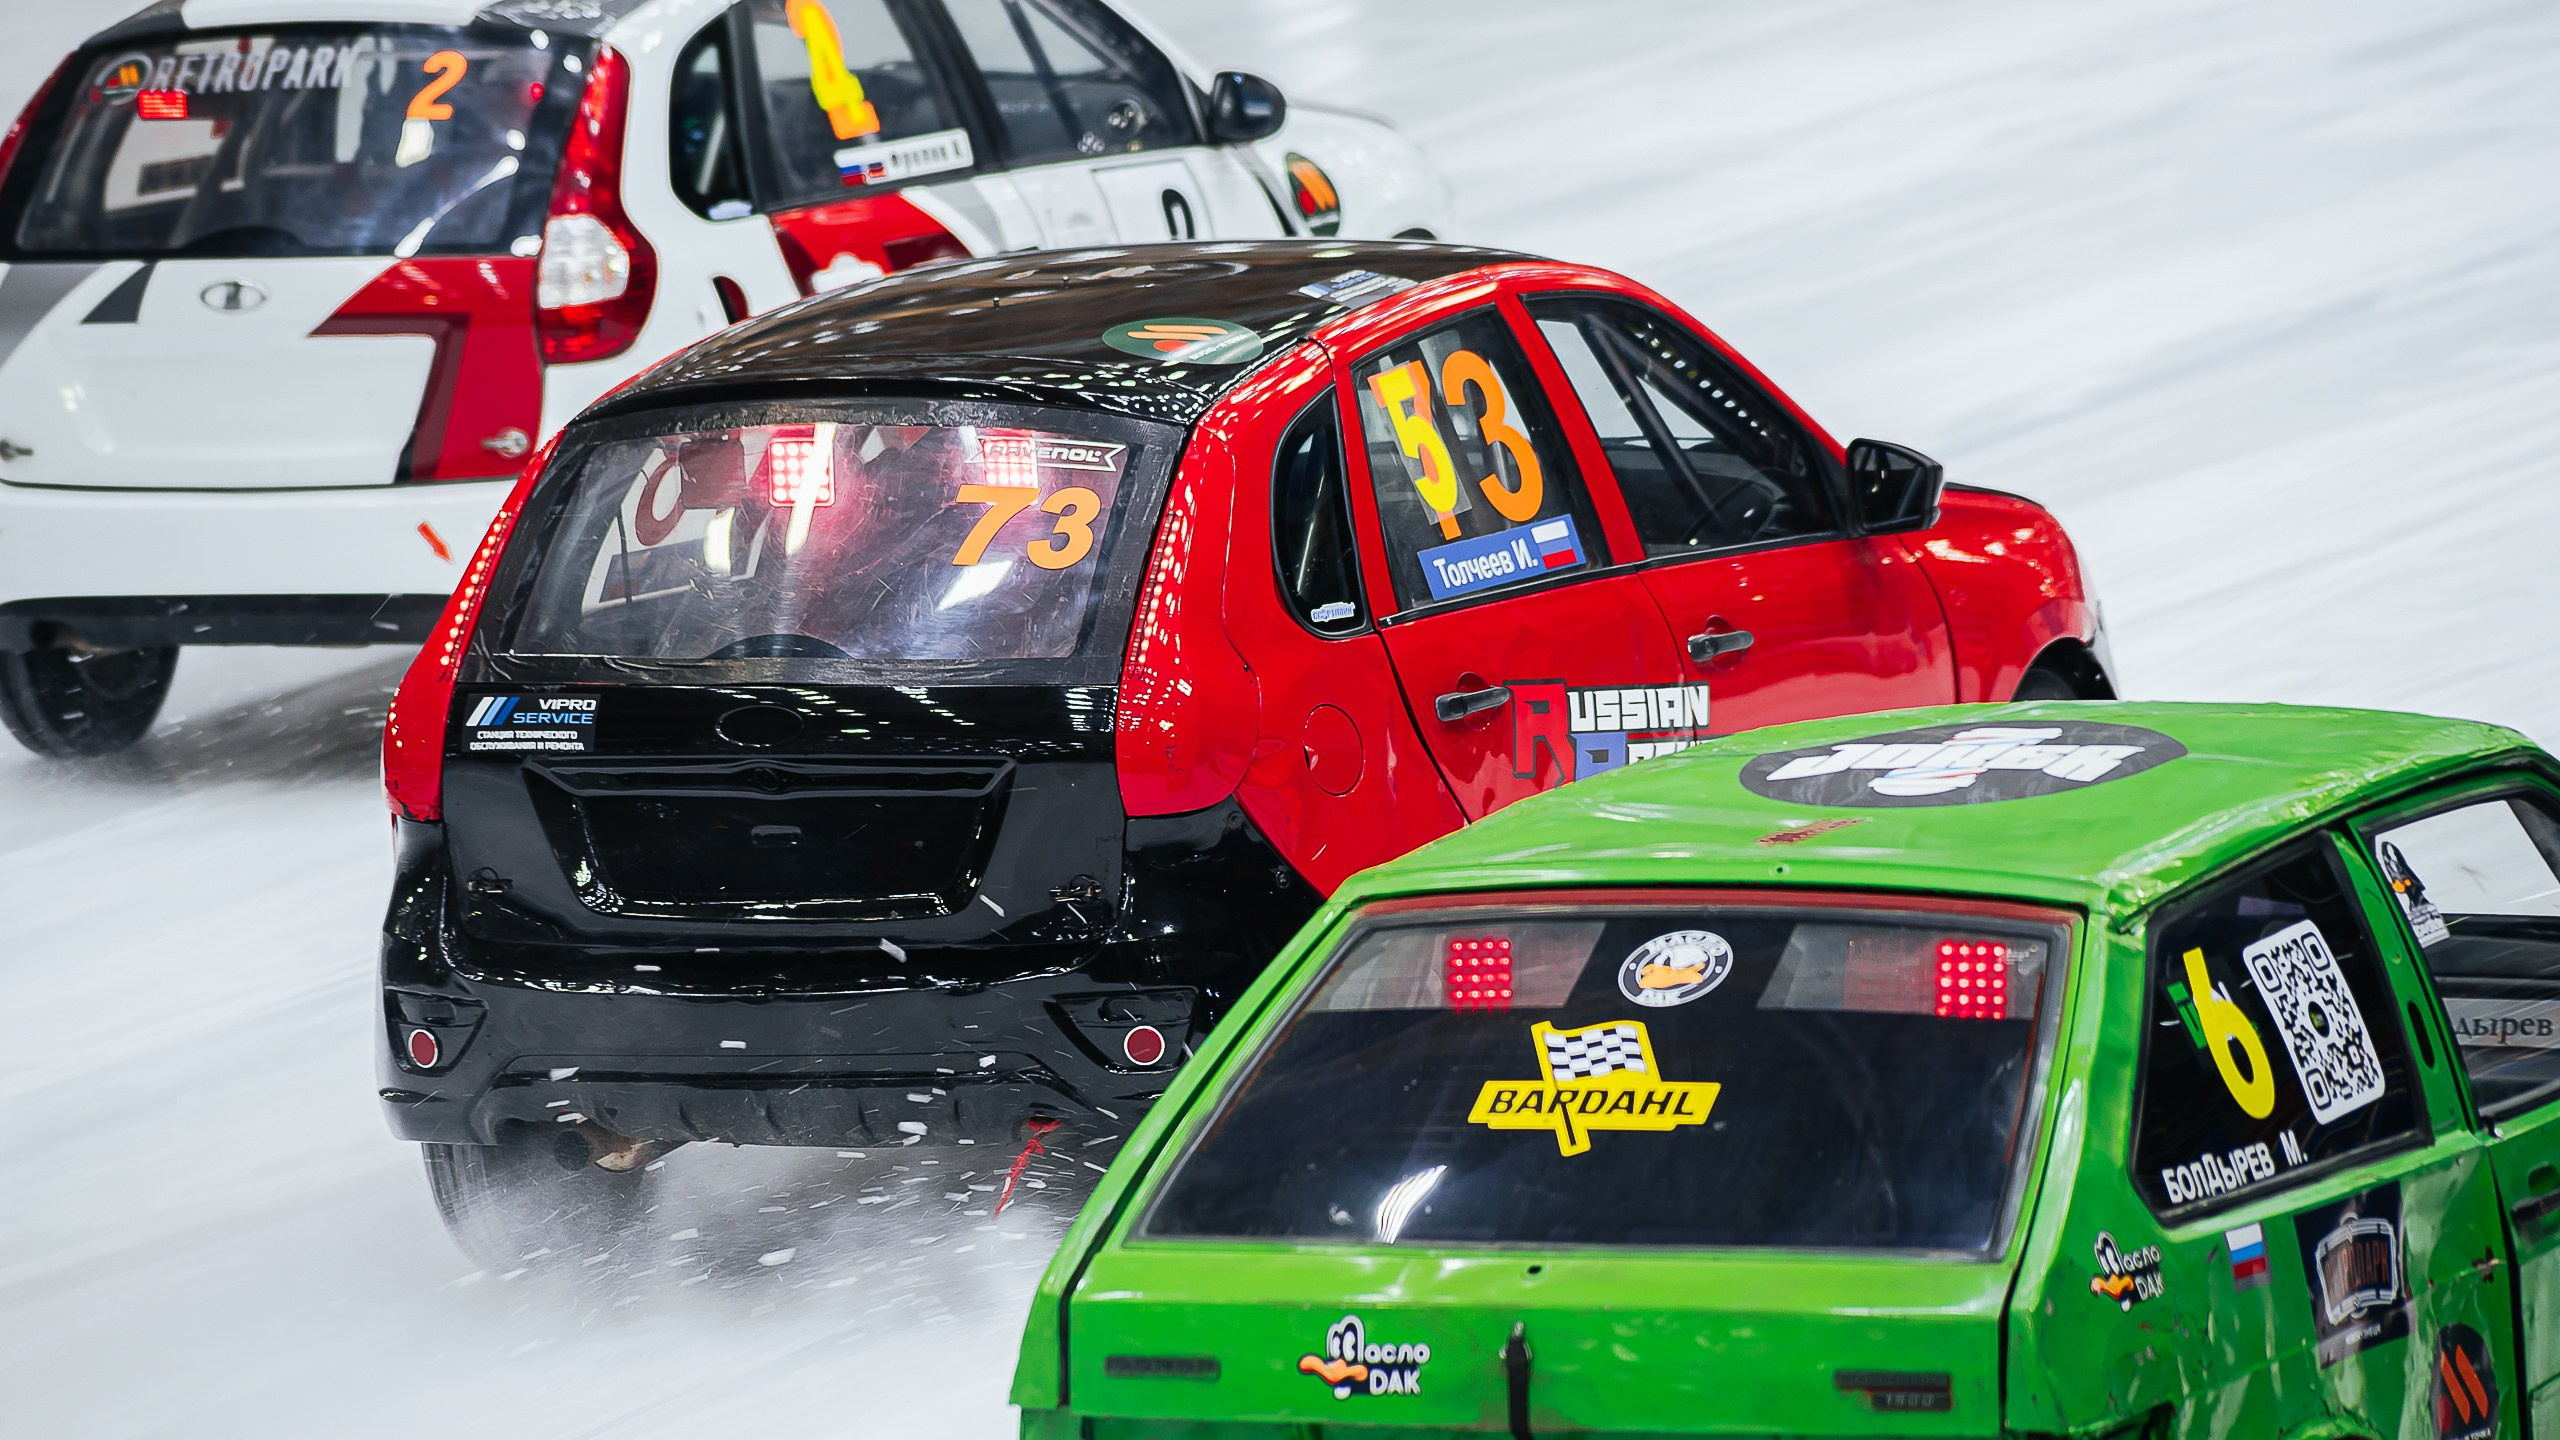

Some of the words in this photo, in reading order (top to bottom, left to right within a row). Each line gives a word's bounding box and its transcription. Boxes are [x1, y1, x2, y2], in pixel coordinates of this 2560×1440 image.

[405, 49, 468, 120] 2
[952, 484, 1101, 570] 73
[1433, 549, 1515, 589] Толчеев
[1511, 537, 1539, 570] И.
[512, 712, 594, 724] SERVICE
[539, 698, 597, 711] VIPRO
[1503, 682, 1710, 782] RUSSIAN
[2183, 947, 2275, 1120] 6
[1488, 1088, 1695, 1119] BARDAHL
[2161, 1141, 2276, 1204] БОЛДЫРЕВ
[2279, 1128, 2310, 1167] М.
